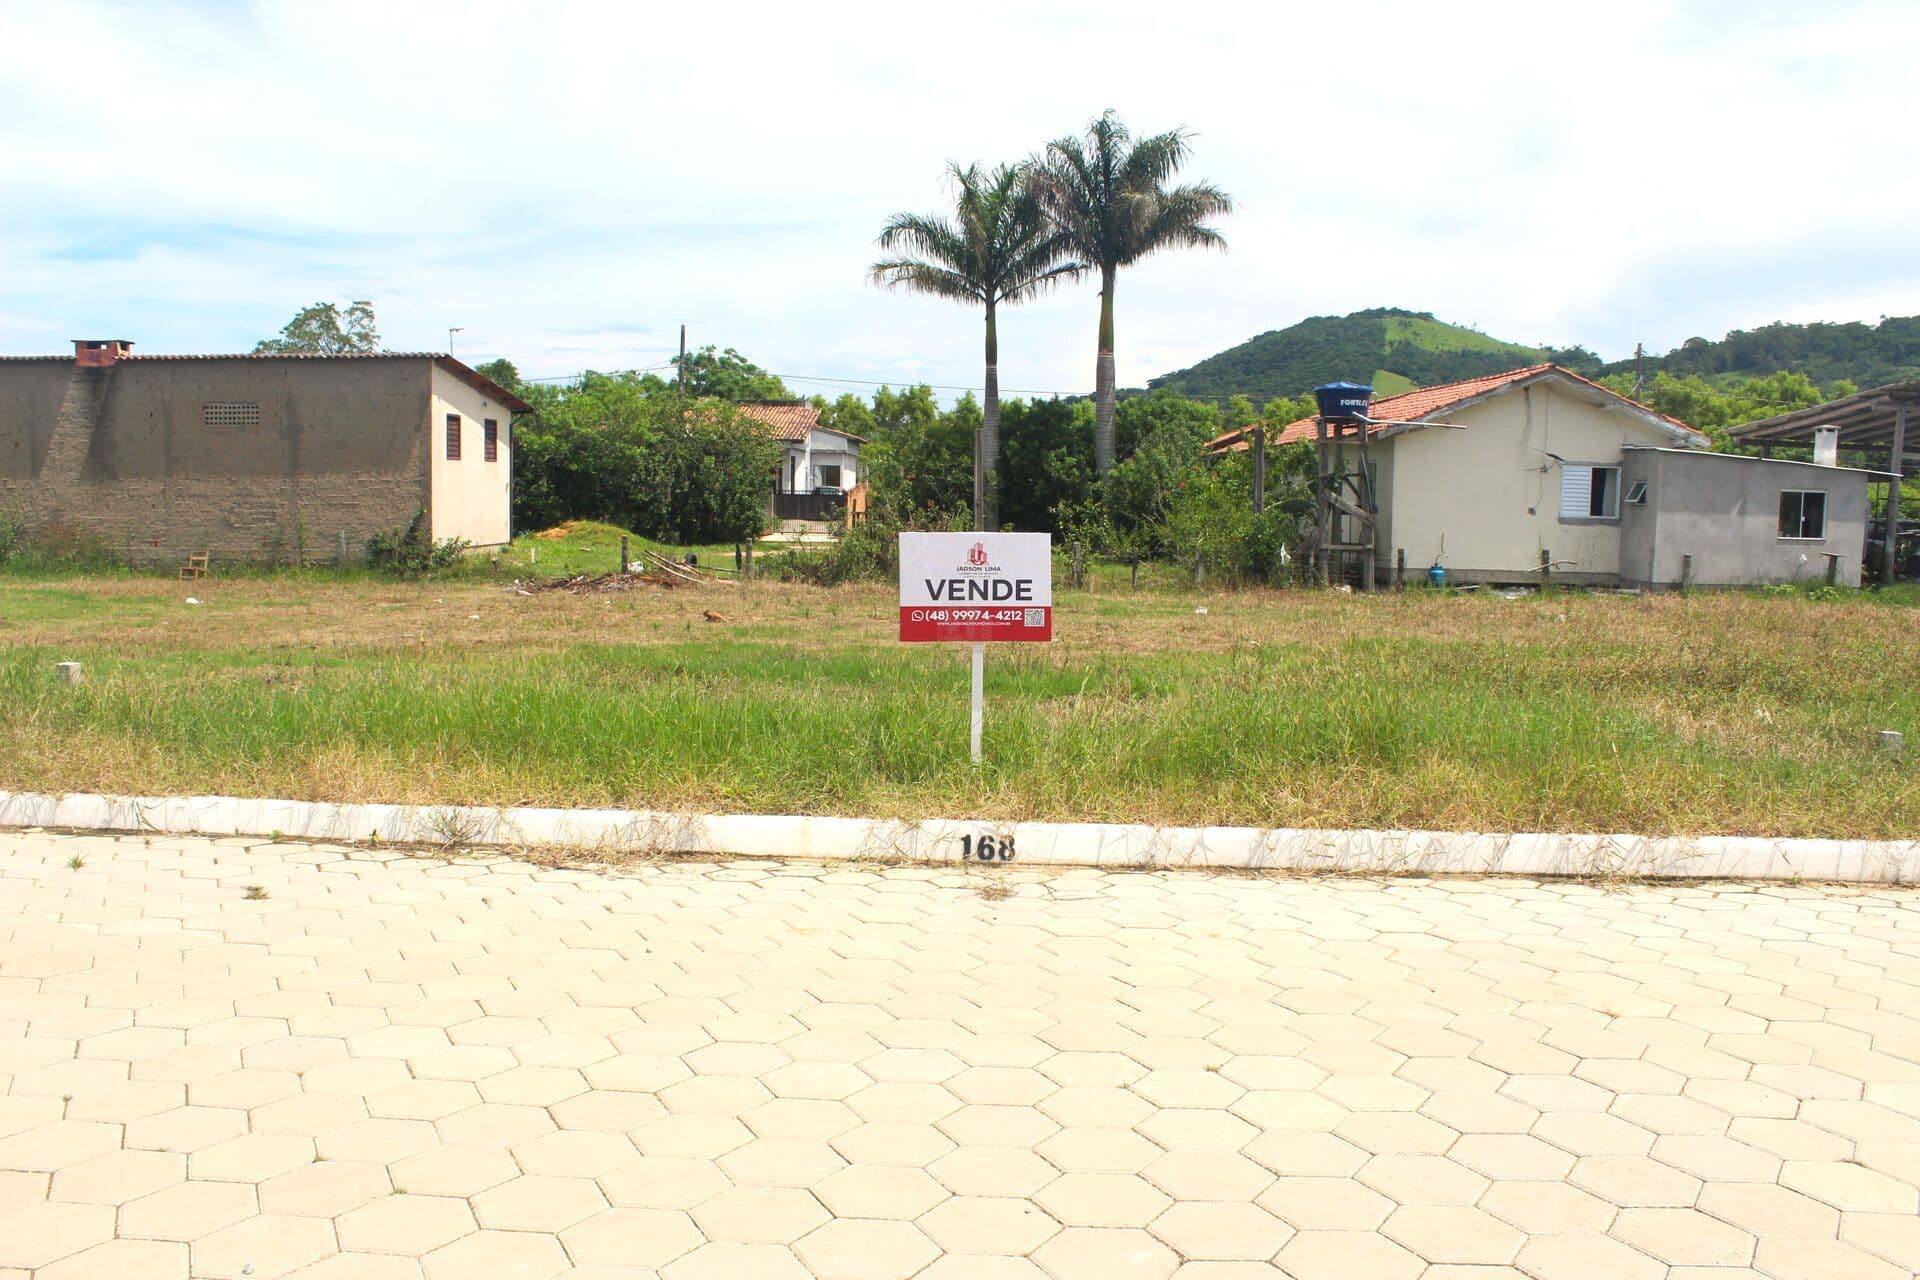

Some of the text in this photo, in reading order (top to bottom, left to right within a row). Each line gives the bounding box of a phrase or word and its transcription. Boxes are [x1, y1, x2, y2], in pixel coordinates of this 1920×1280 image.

[925, 579, 1033, 601] VENDE
[925, 610, 1023, 622] (48) 99974-4212
[961, 834, 1016, 861] 168
